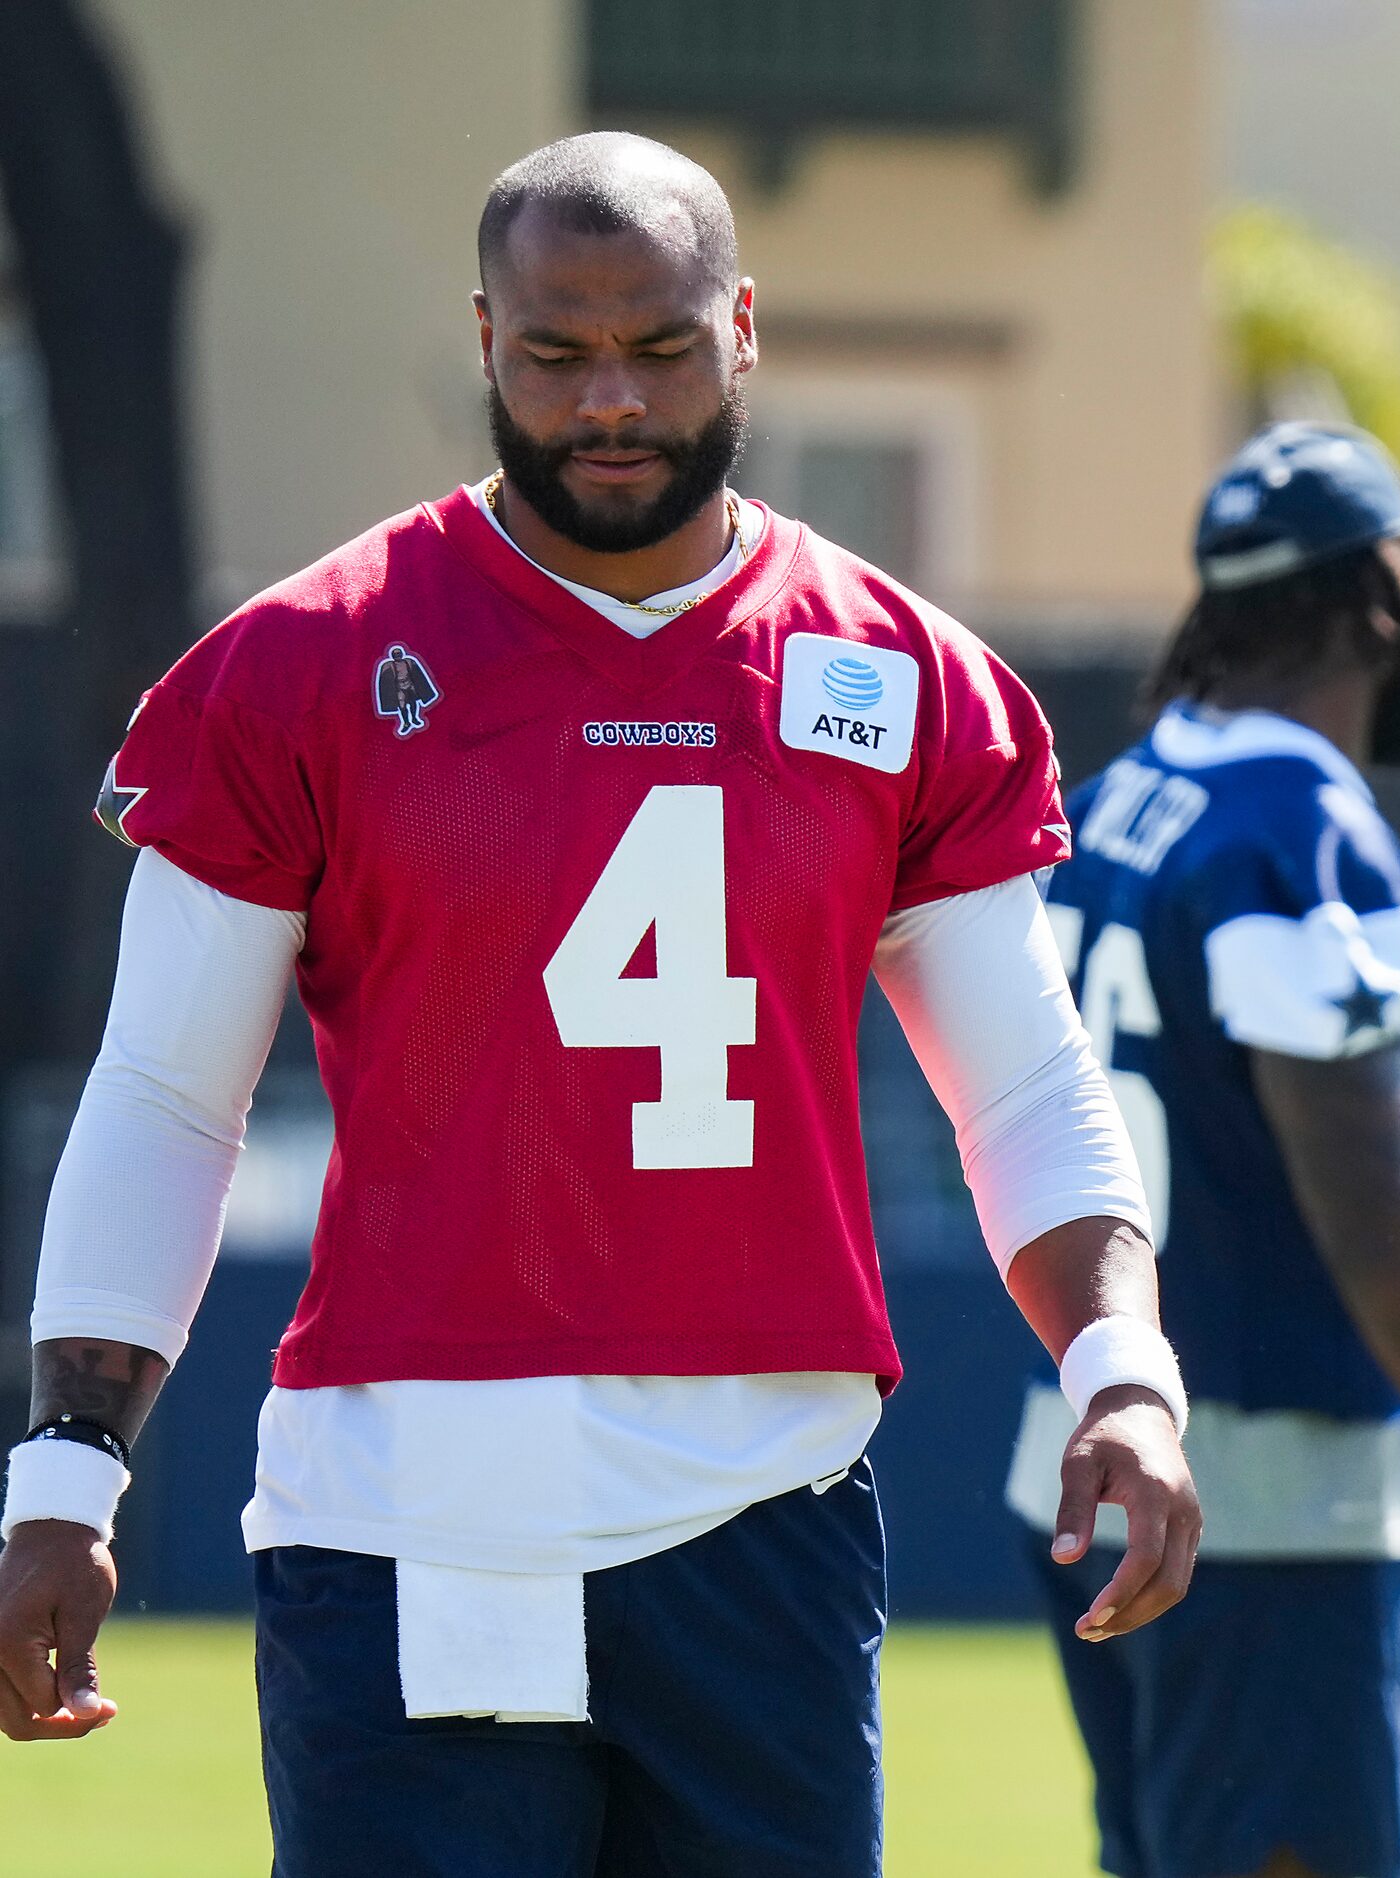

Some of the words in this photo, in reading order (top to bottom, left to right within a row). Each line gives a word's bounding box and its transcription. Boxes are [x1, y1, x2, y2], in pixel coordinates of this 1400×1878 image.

[583, 722, 716, 747] COWBOYS
[811, 713, 887, 750] AT&T
[542, 784, 757, 1170] 4
